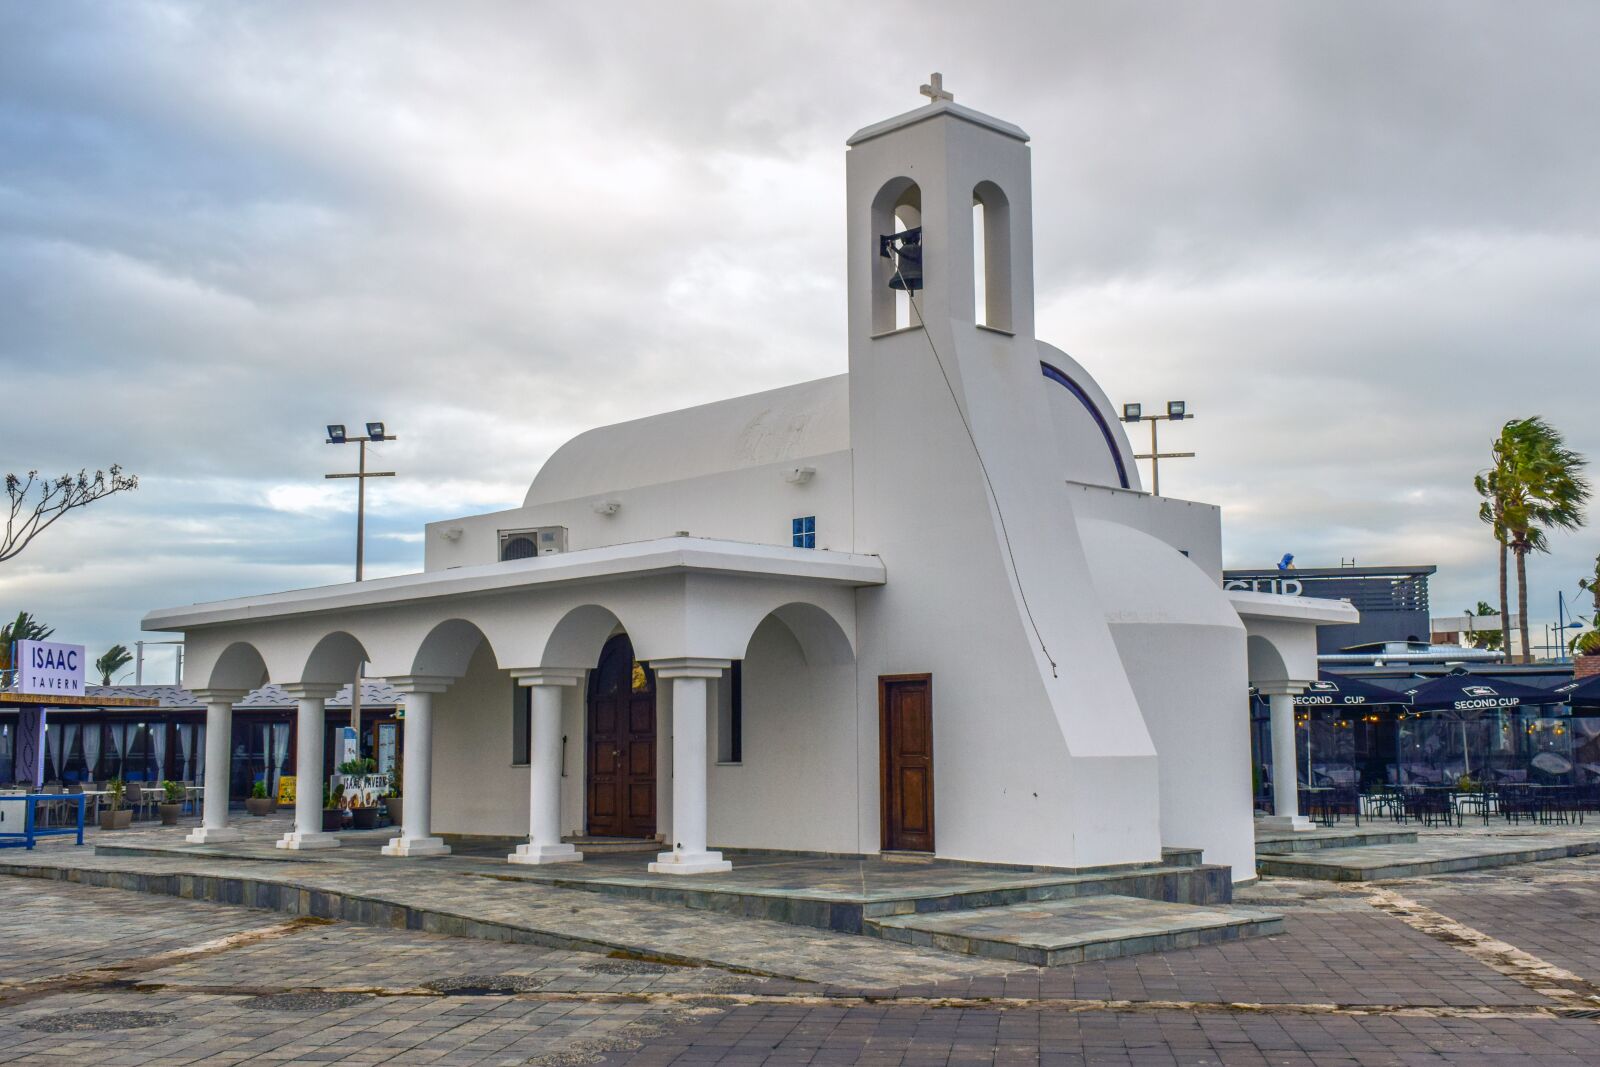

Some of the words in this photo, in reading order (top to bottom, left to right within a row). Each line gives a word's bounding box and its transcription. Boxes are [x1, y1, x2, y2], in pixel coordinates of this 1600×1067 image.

[32, 647, 77, 671] ISAAC
[32, 676, 78, 690] TAVERN
[1291, 696, 1333, 705] SECOND
[1344, 696, 1365, 704] CUP
[1454, 698, 1497, 709] SECOND
[1498, 697, 1520, 706] CUP
